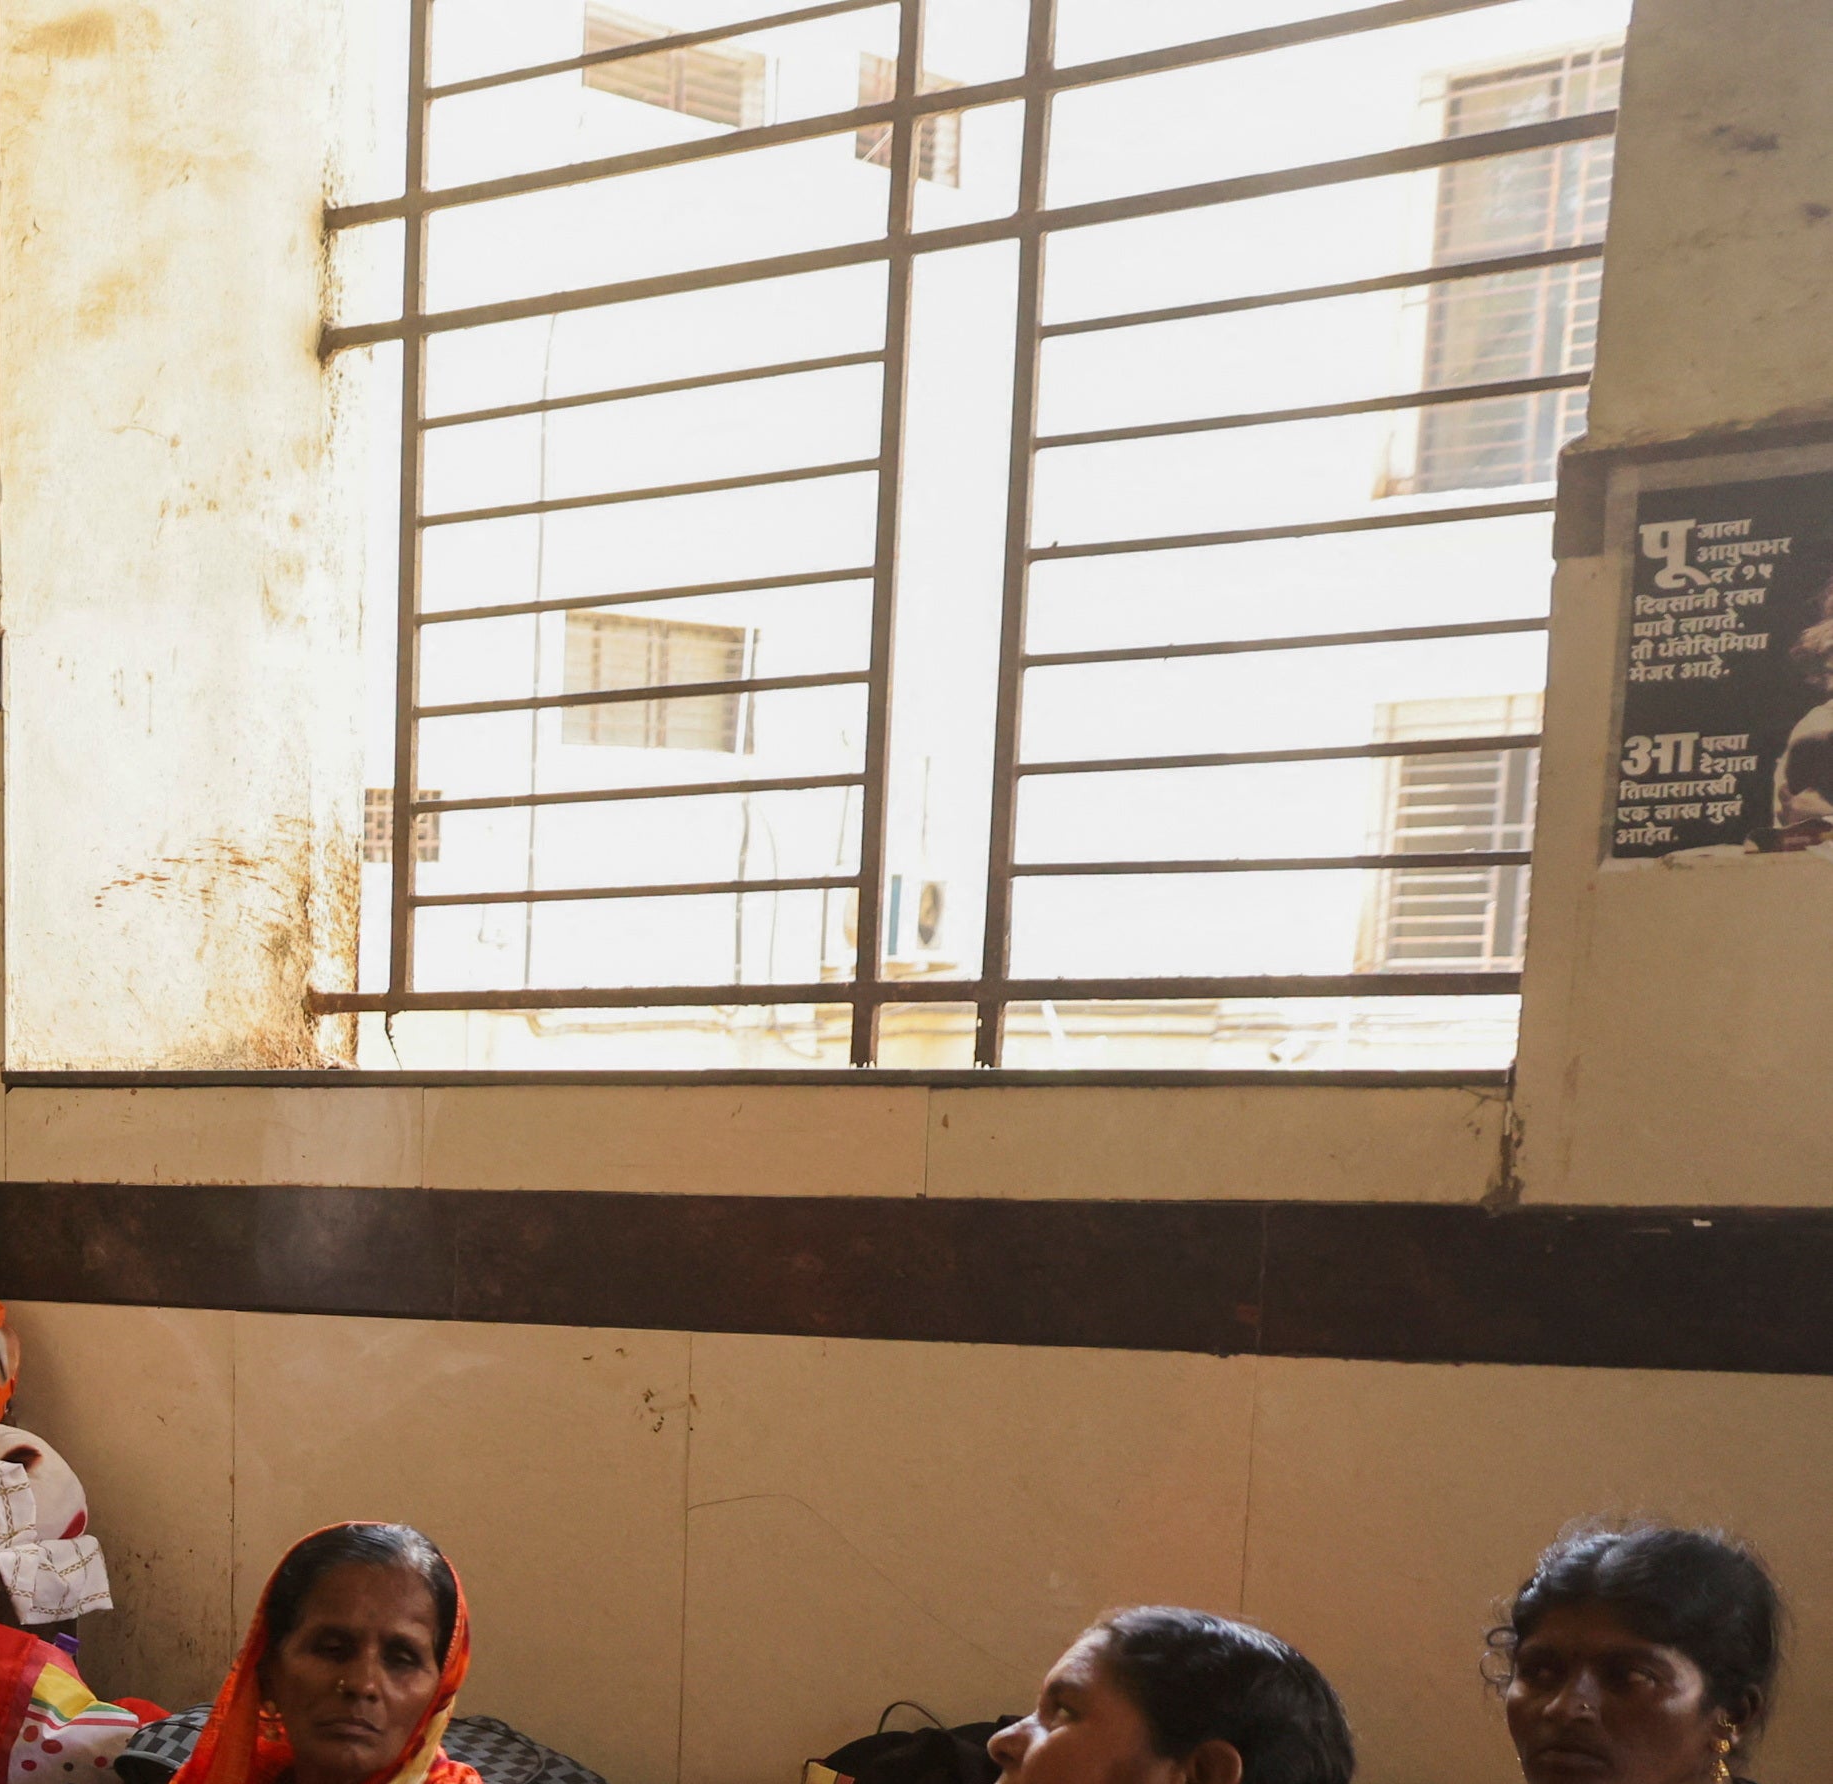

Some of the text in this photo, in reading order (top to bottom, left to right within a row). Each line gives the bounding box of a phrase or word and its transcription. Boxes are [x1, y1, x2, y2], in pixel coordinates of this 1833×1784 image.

[1638, 518, 1711, 589] पू
[1696, 537, 1792, 566] आयुष्यभर
[1634, 588, 1766, 616] दिवसांनी रक्त
[1678, 608, 1745, 634] लागते.
[1631, 638, 1655, 660] ती
[1629, 654, 1731, 683] मेजर आहे.
[1621, 731, 1700, 776] आ
[1617, 804, 1651, 824] एक
[1654, 802, 1702, 821] लाख
